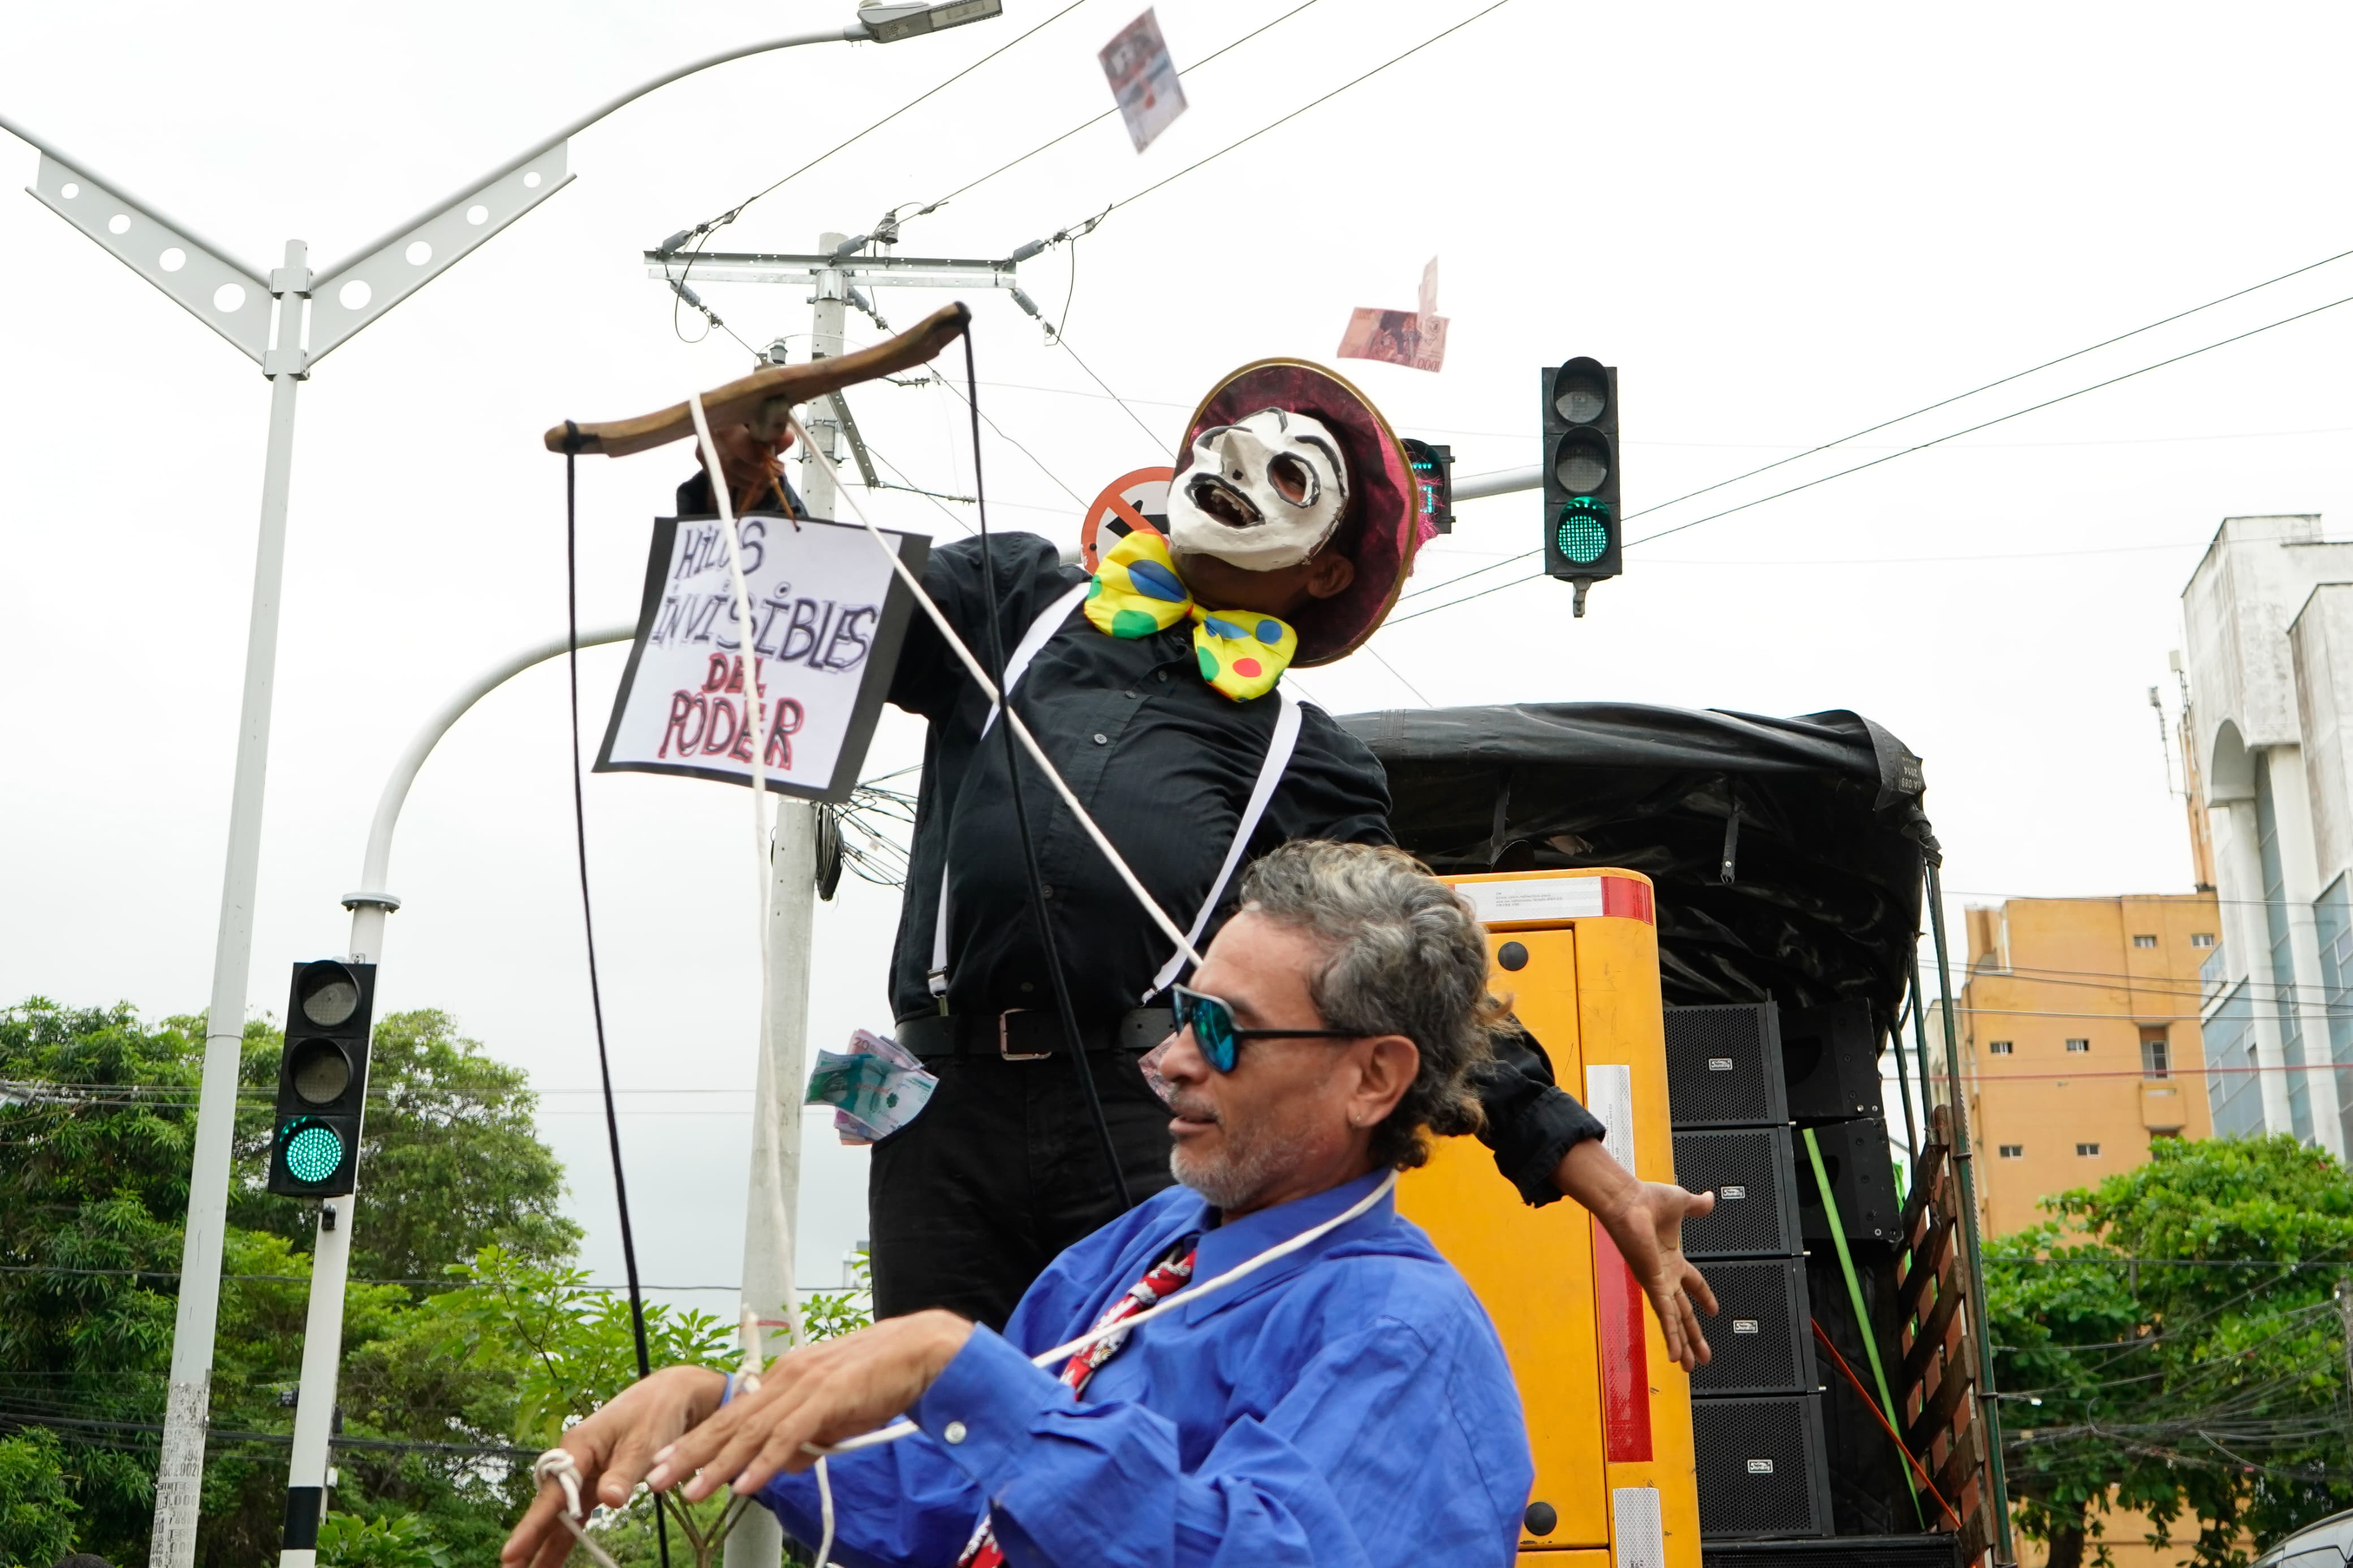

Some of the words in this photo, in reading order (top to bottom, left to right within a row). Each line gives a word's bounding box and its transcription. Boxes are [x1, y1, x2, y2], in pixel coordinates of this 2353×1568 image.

[650, 581, 880, 673] INVISIBLES
[701, 652, 766, 698] DEL
[658, 690, 805, 770] PODER
